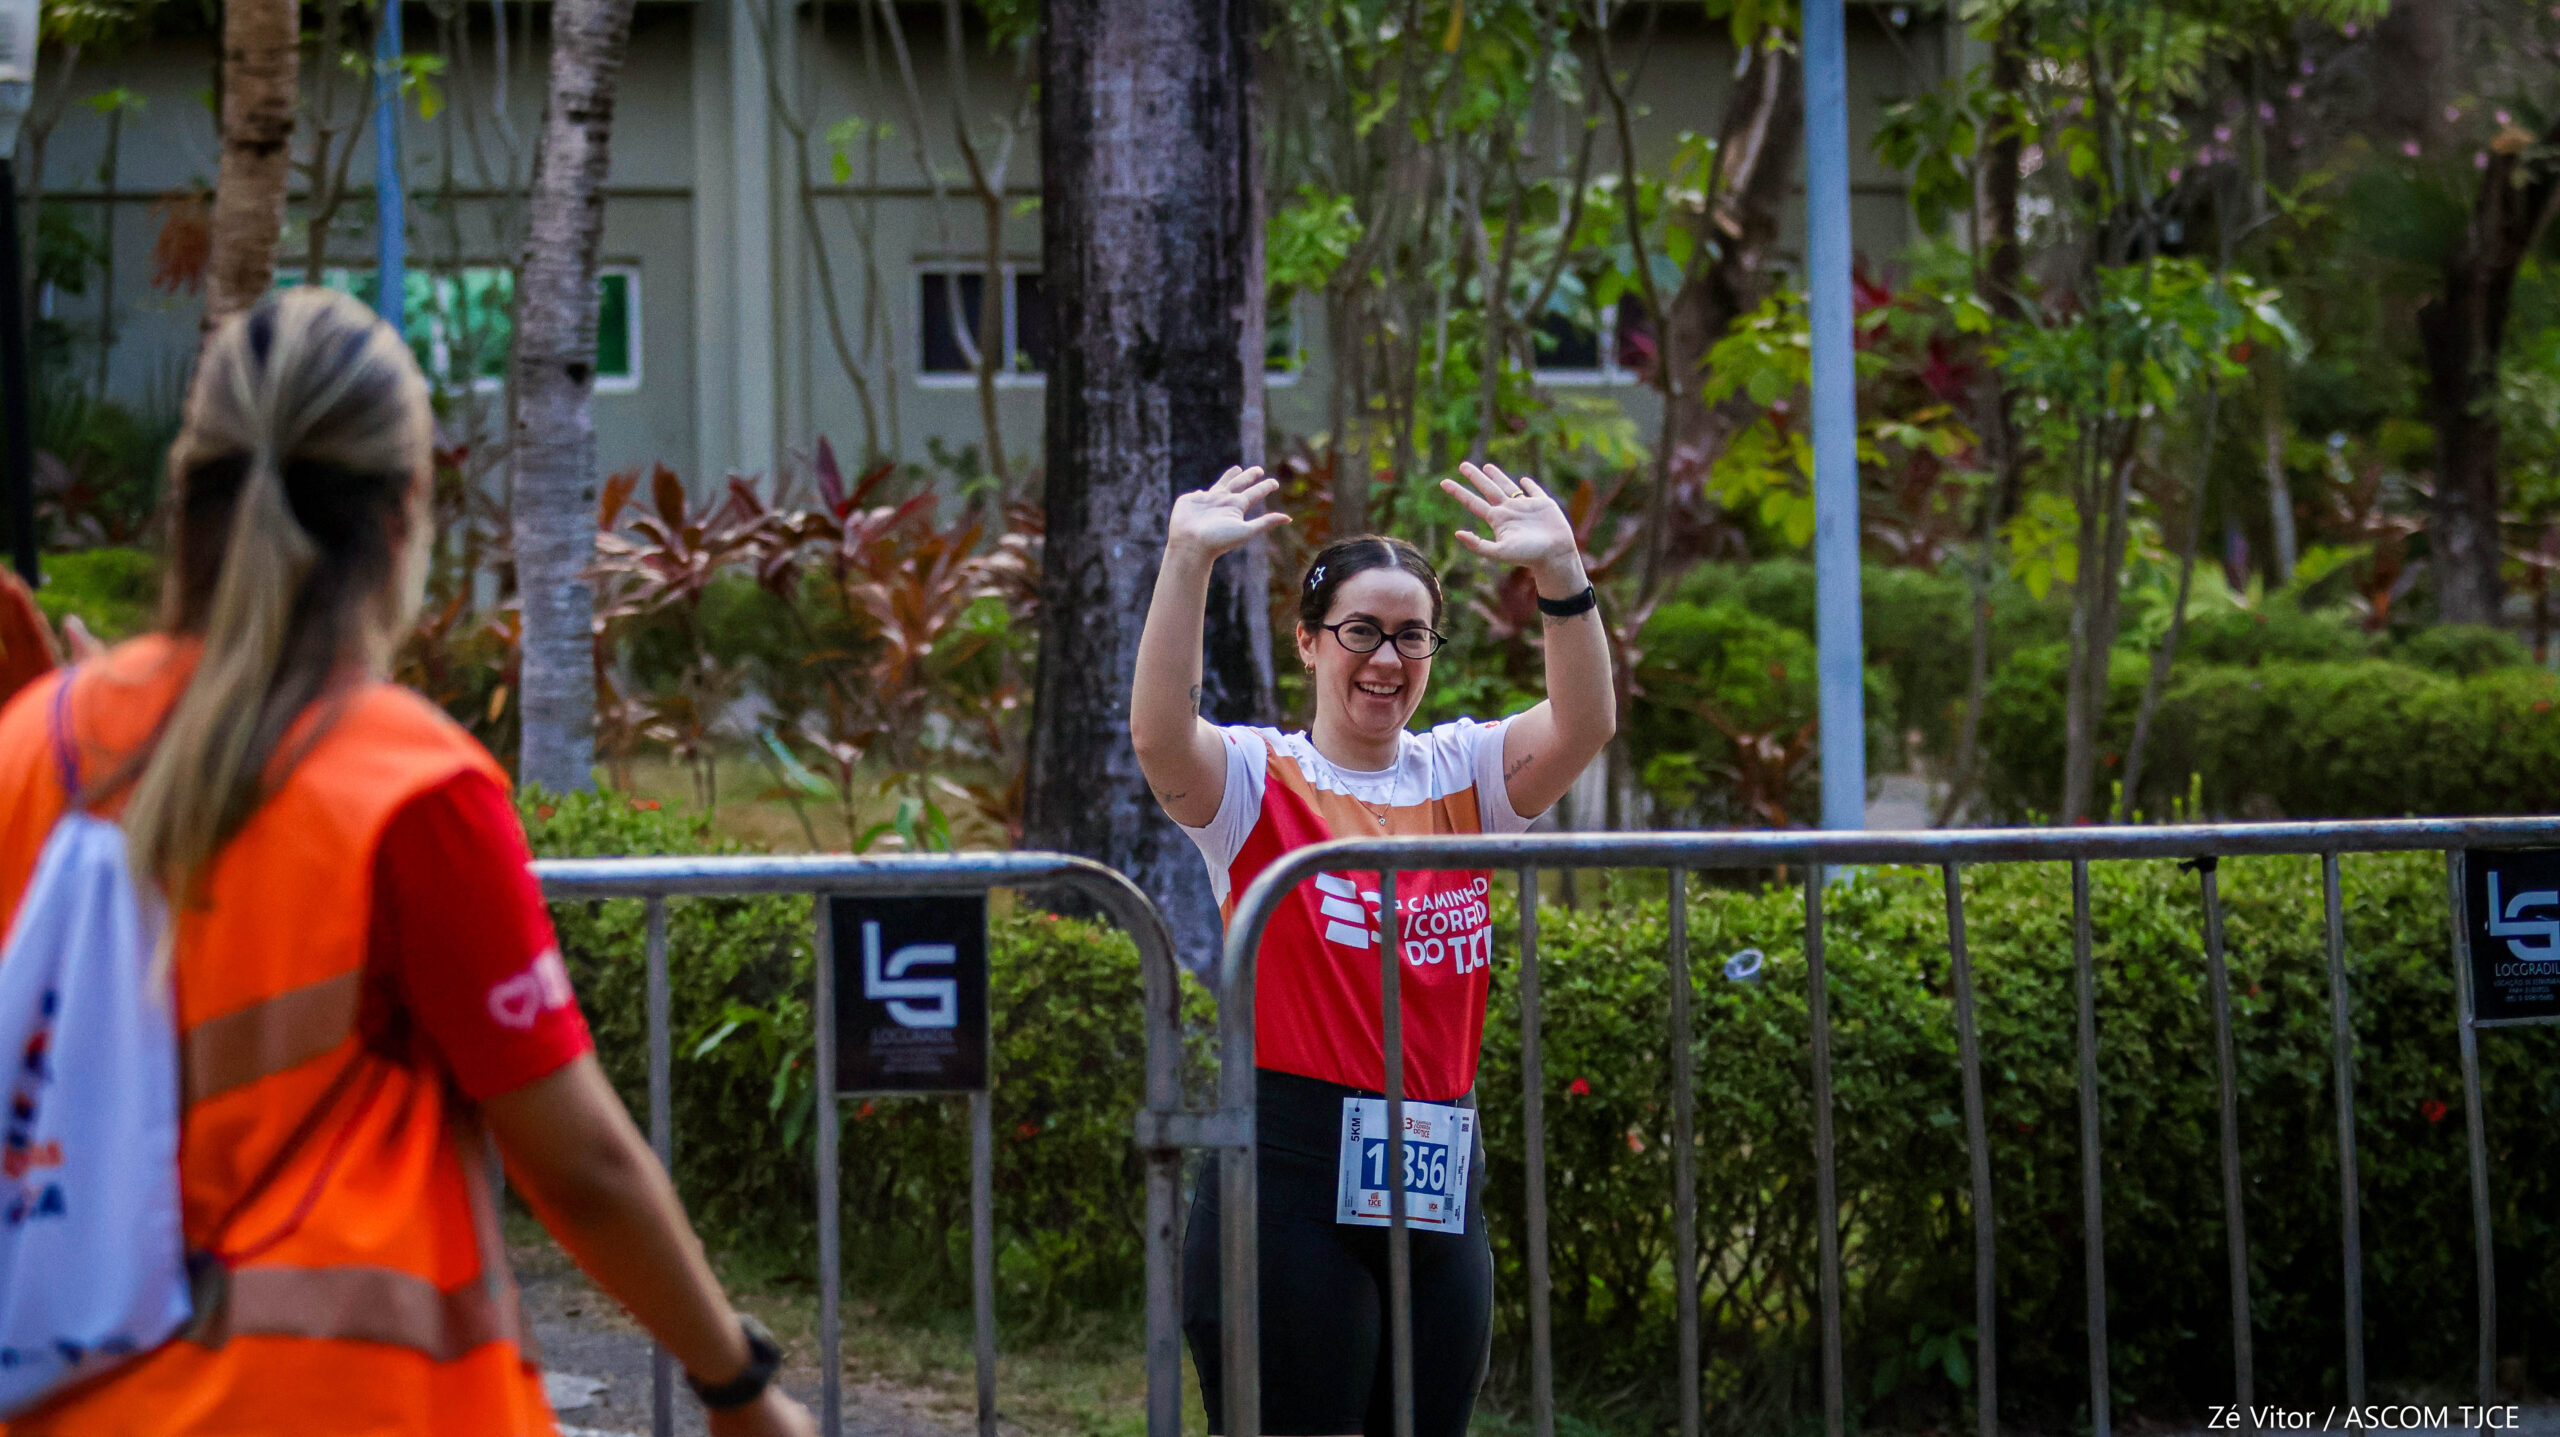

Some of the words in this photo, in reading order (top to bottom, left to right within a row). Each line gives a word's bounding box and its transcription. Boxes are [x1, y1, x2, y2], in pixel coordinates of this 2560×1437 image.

[1404, 937, 1446, 966] DO
[2495, 962, 2560, 977] LOCGRADIL
[1350, 1117, 1361, 1142] 5KM
